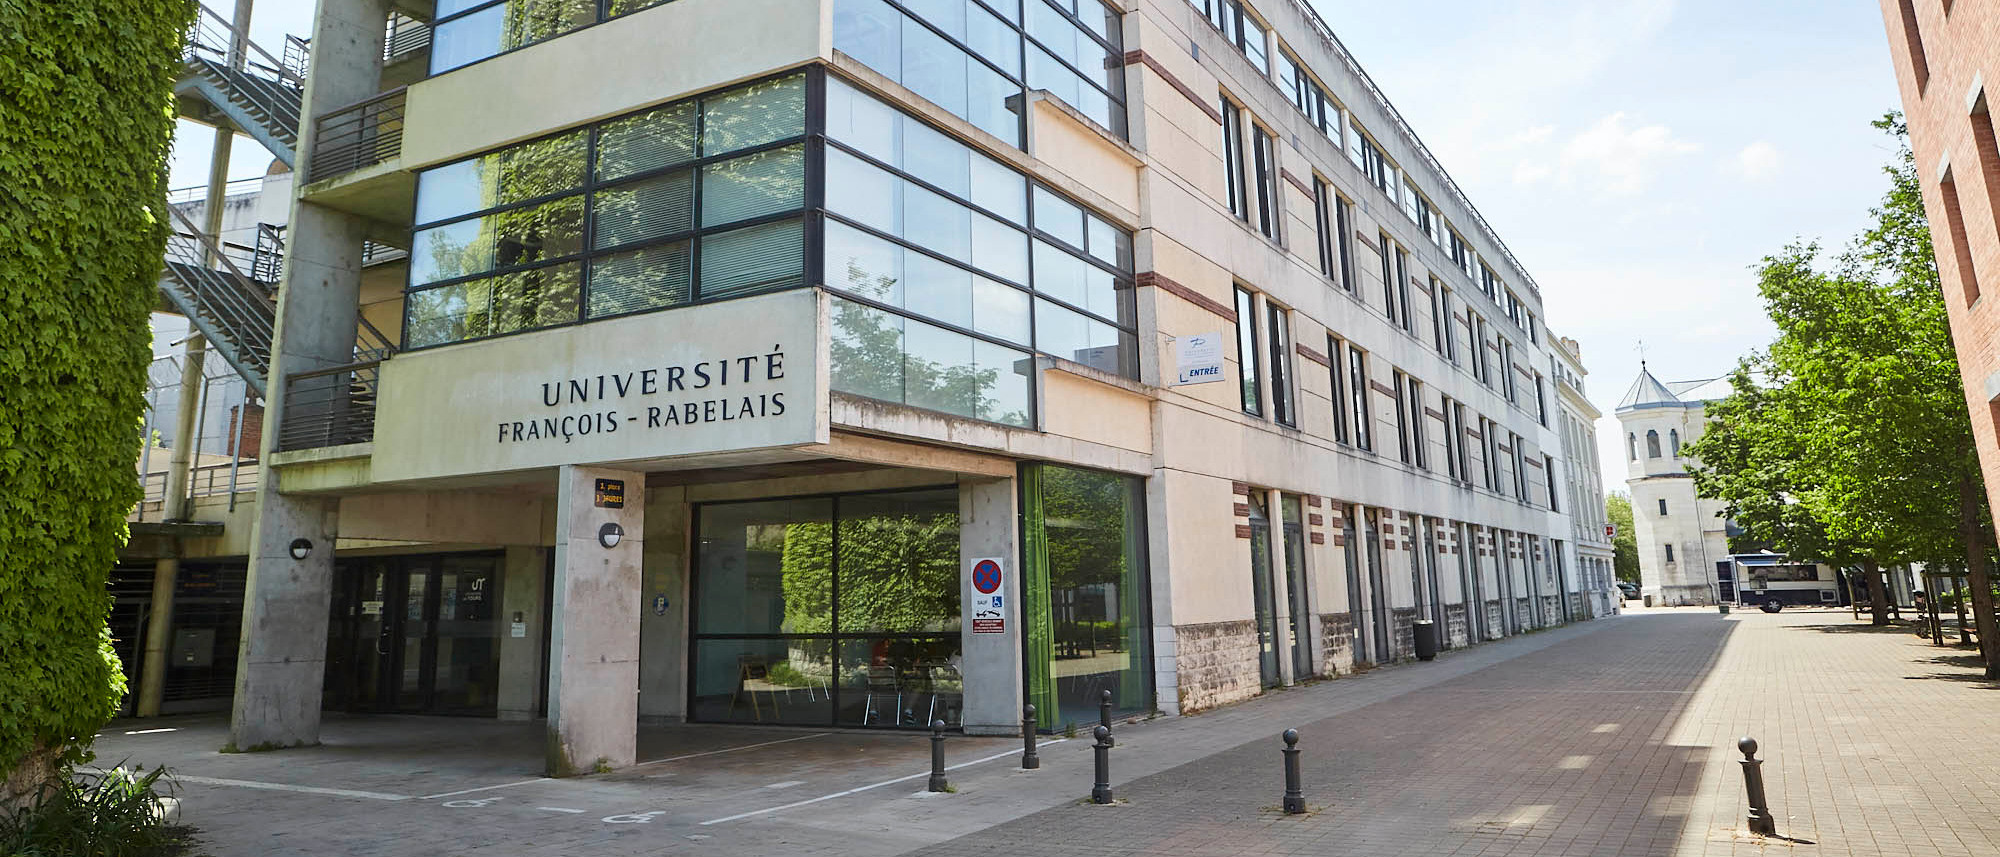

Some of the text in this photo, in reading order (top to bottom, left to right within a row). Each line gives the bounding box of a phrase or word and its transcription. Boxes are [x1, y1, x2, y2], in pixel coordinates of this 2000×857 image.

[541, 344, 785, 407] UNIVERSITÉ
[1189, 365, 1219, 377] ENTRÉE
[498, 410, 618, 443] FRANÇOIS
[647, 392, 786, 428] RABELAIS
